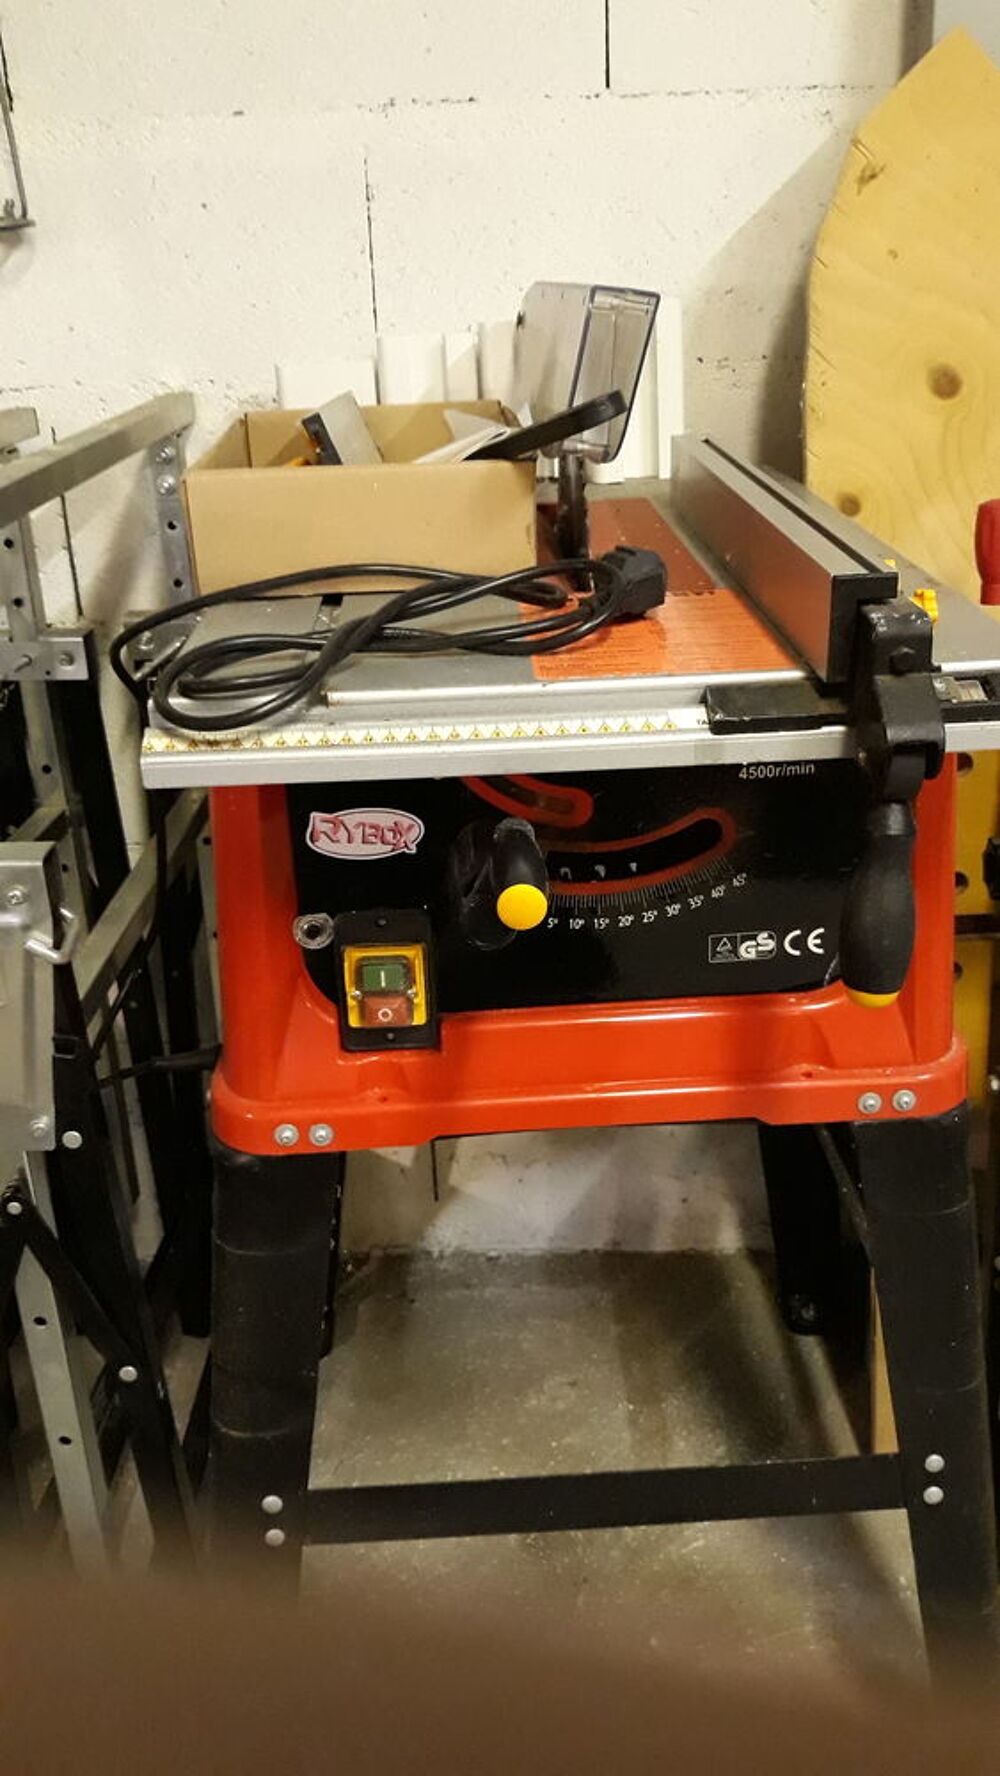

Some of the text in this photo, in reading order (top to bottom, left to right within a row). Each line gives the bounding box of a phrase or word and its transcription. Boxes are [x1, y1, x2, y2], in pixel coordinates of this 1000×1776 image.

[738, 763, 815, 780] 4500r/min
[740, 931, 776, 959] GS
[783, 927, 825, 956] CE
